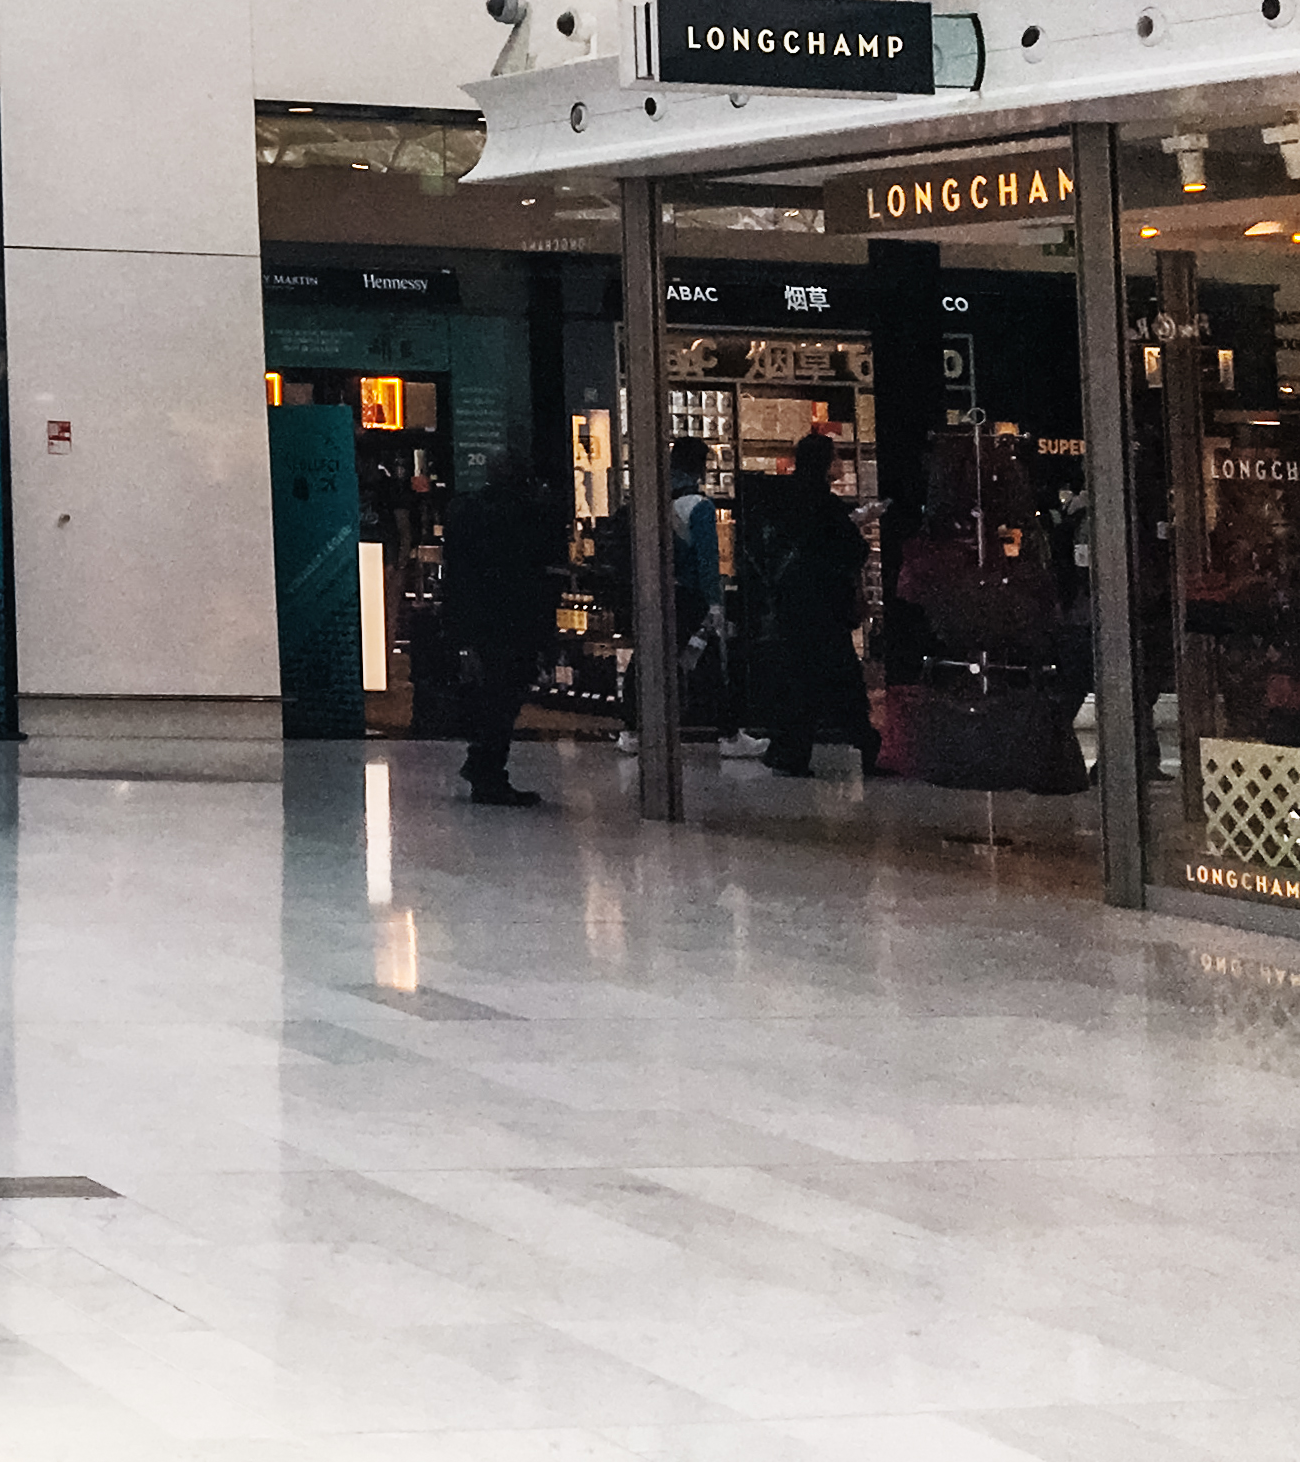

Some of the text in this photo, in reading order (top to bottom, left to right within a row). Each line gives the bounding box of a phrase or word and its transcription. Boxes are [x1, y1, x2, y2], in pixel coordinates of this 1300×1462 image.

[687, 26, 904, 58] LONGCHAMP
[274, 274, 319, 286] MARTIN
[362, 273, 429, 293] Hennessy
[666, 285, 719, 303] ABAC
[784, 285, 831, 312] 烟草
[942, 296, 969, 312] CO
